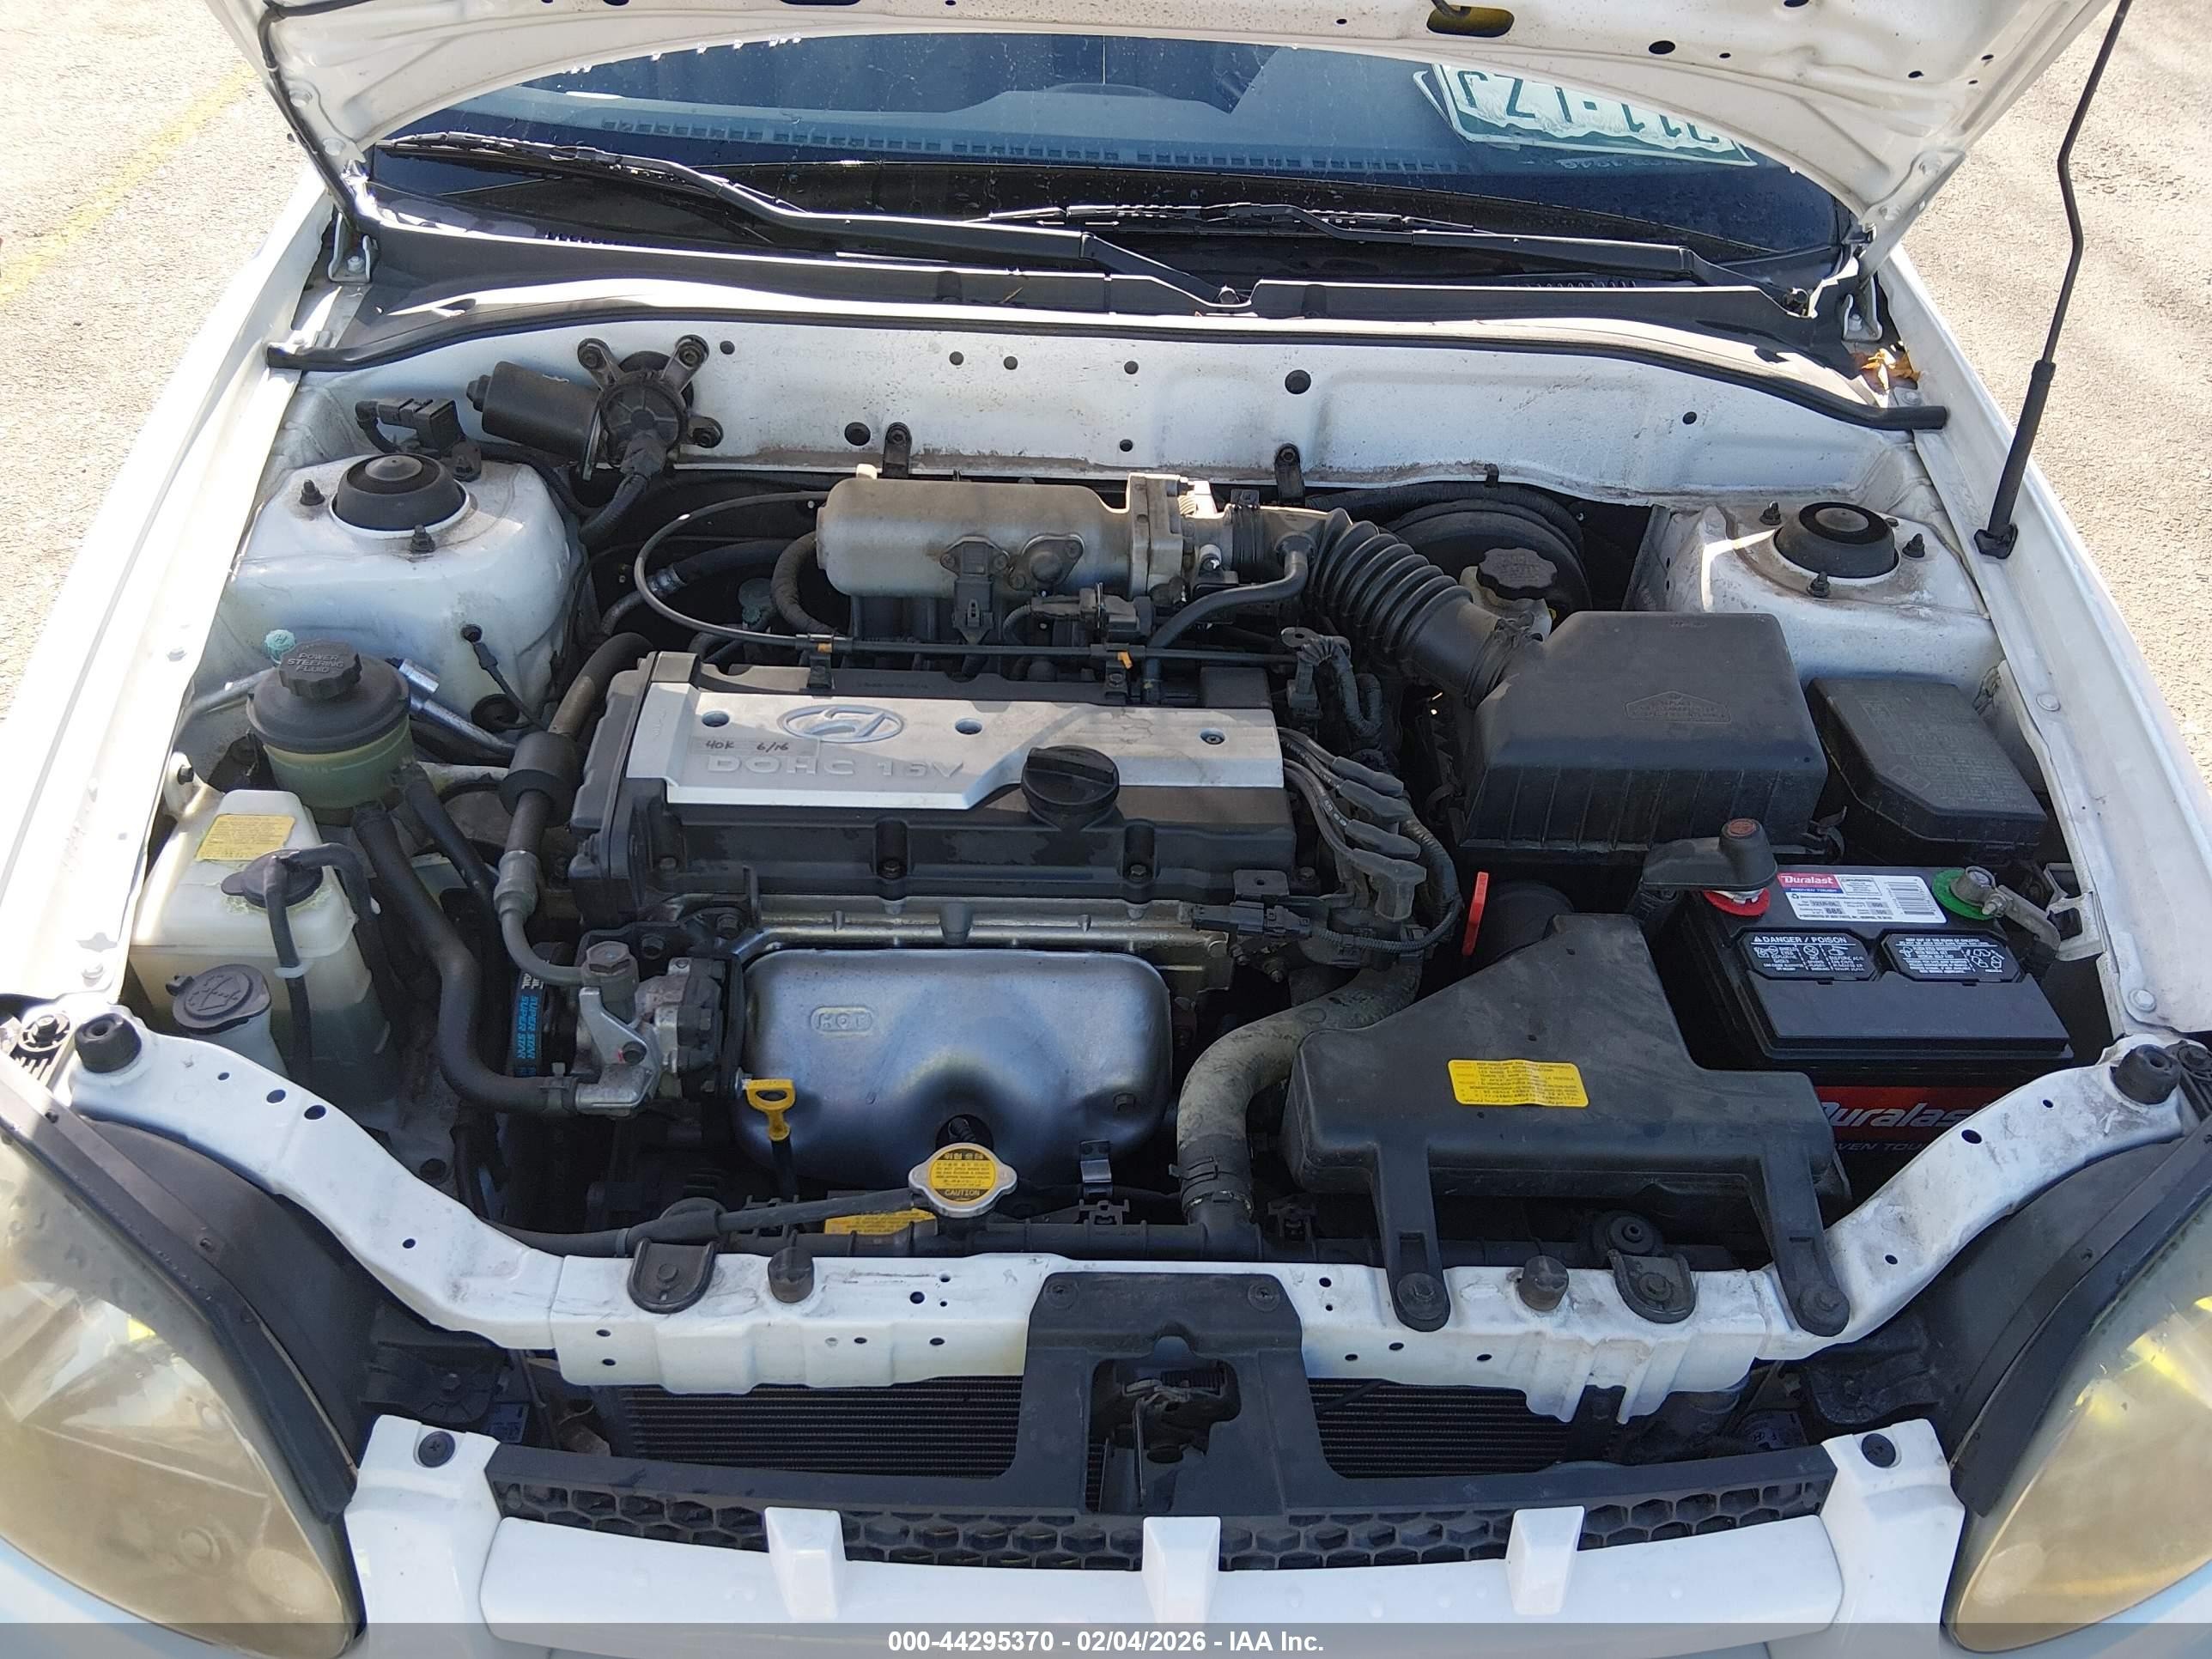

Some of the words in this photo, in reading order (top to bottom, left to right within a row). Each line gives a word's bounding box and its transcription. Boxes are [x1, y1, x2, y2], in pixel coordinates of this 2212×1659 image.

[288, 658, 344, 668] STEERING
[295, 665, 330, 673] FLUID
[706, 740, 735, 750] 40K
[707, 756, 855, 775] DOHC
[1781, 875, 1834, 884] Duralast
[518, 995, 529, 1031] SUPER
[527, 995, 538, 1031] SUPER
[517, 1033, 526, 1059] STAR
[526, 1033, 536, 1059] STAR
[1821, 1101, 1979, 1127] Duralas
[1834, 1142, 1878, 1152] VEN
[1883, 1142, 1925, 1152] TOU
